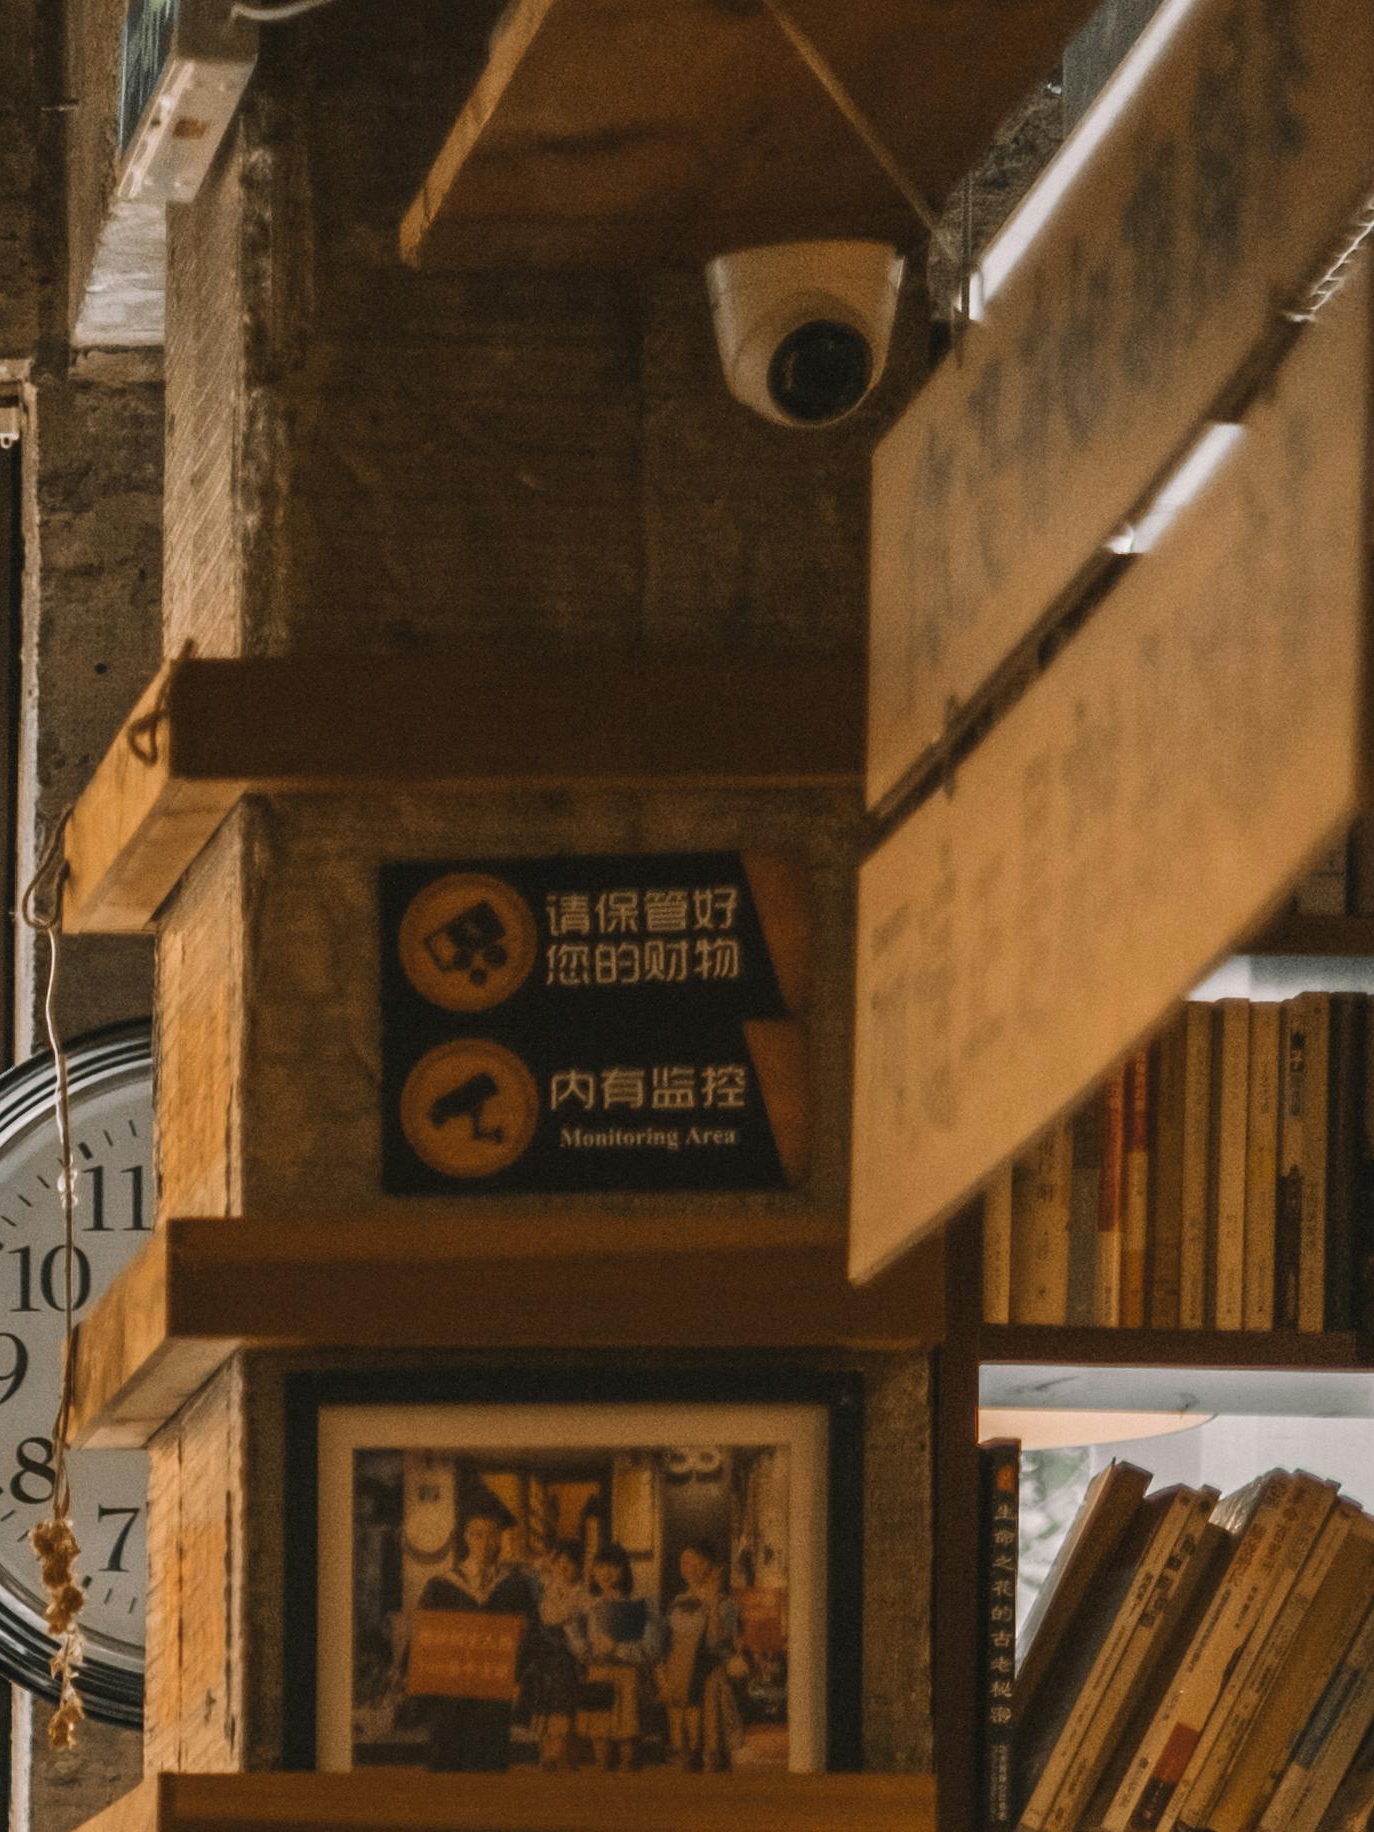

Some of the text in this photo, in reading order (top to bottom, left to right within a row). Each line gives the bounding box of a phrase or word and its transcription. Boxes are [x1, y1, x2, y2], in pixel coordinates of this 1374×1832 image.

[544, 885, 740, 937] 请保管好
[544, 938, 741, 986] 您的财物
[549, 1065, 747, 1111] 内有监控
[559, 1126, 736, 1151] Monitoring Area
[83, 1164, 153, 1232] 11
[8, 1243, 92, 1313] 10
[10, 1435, 57, 1505] 8
[97, 1506, 140, 1572] 7
